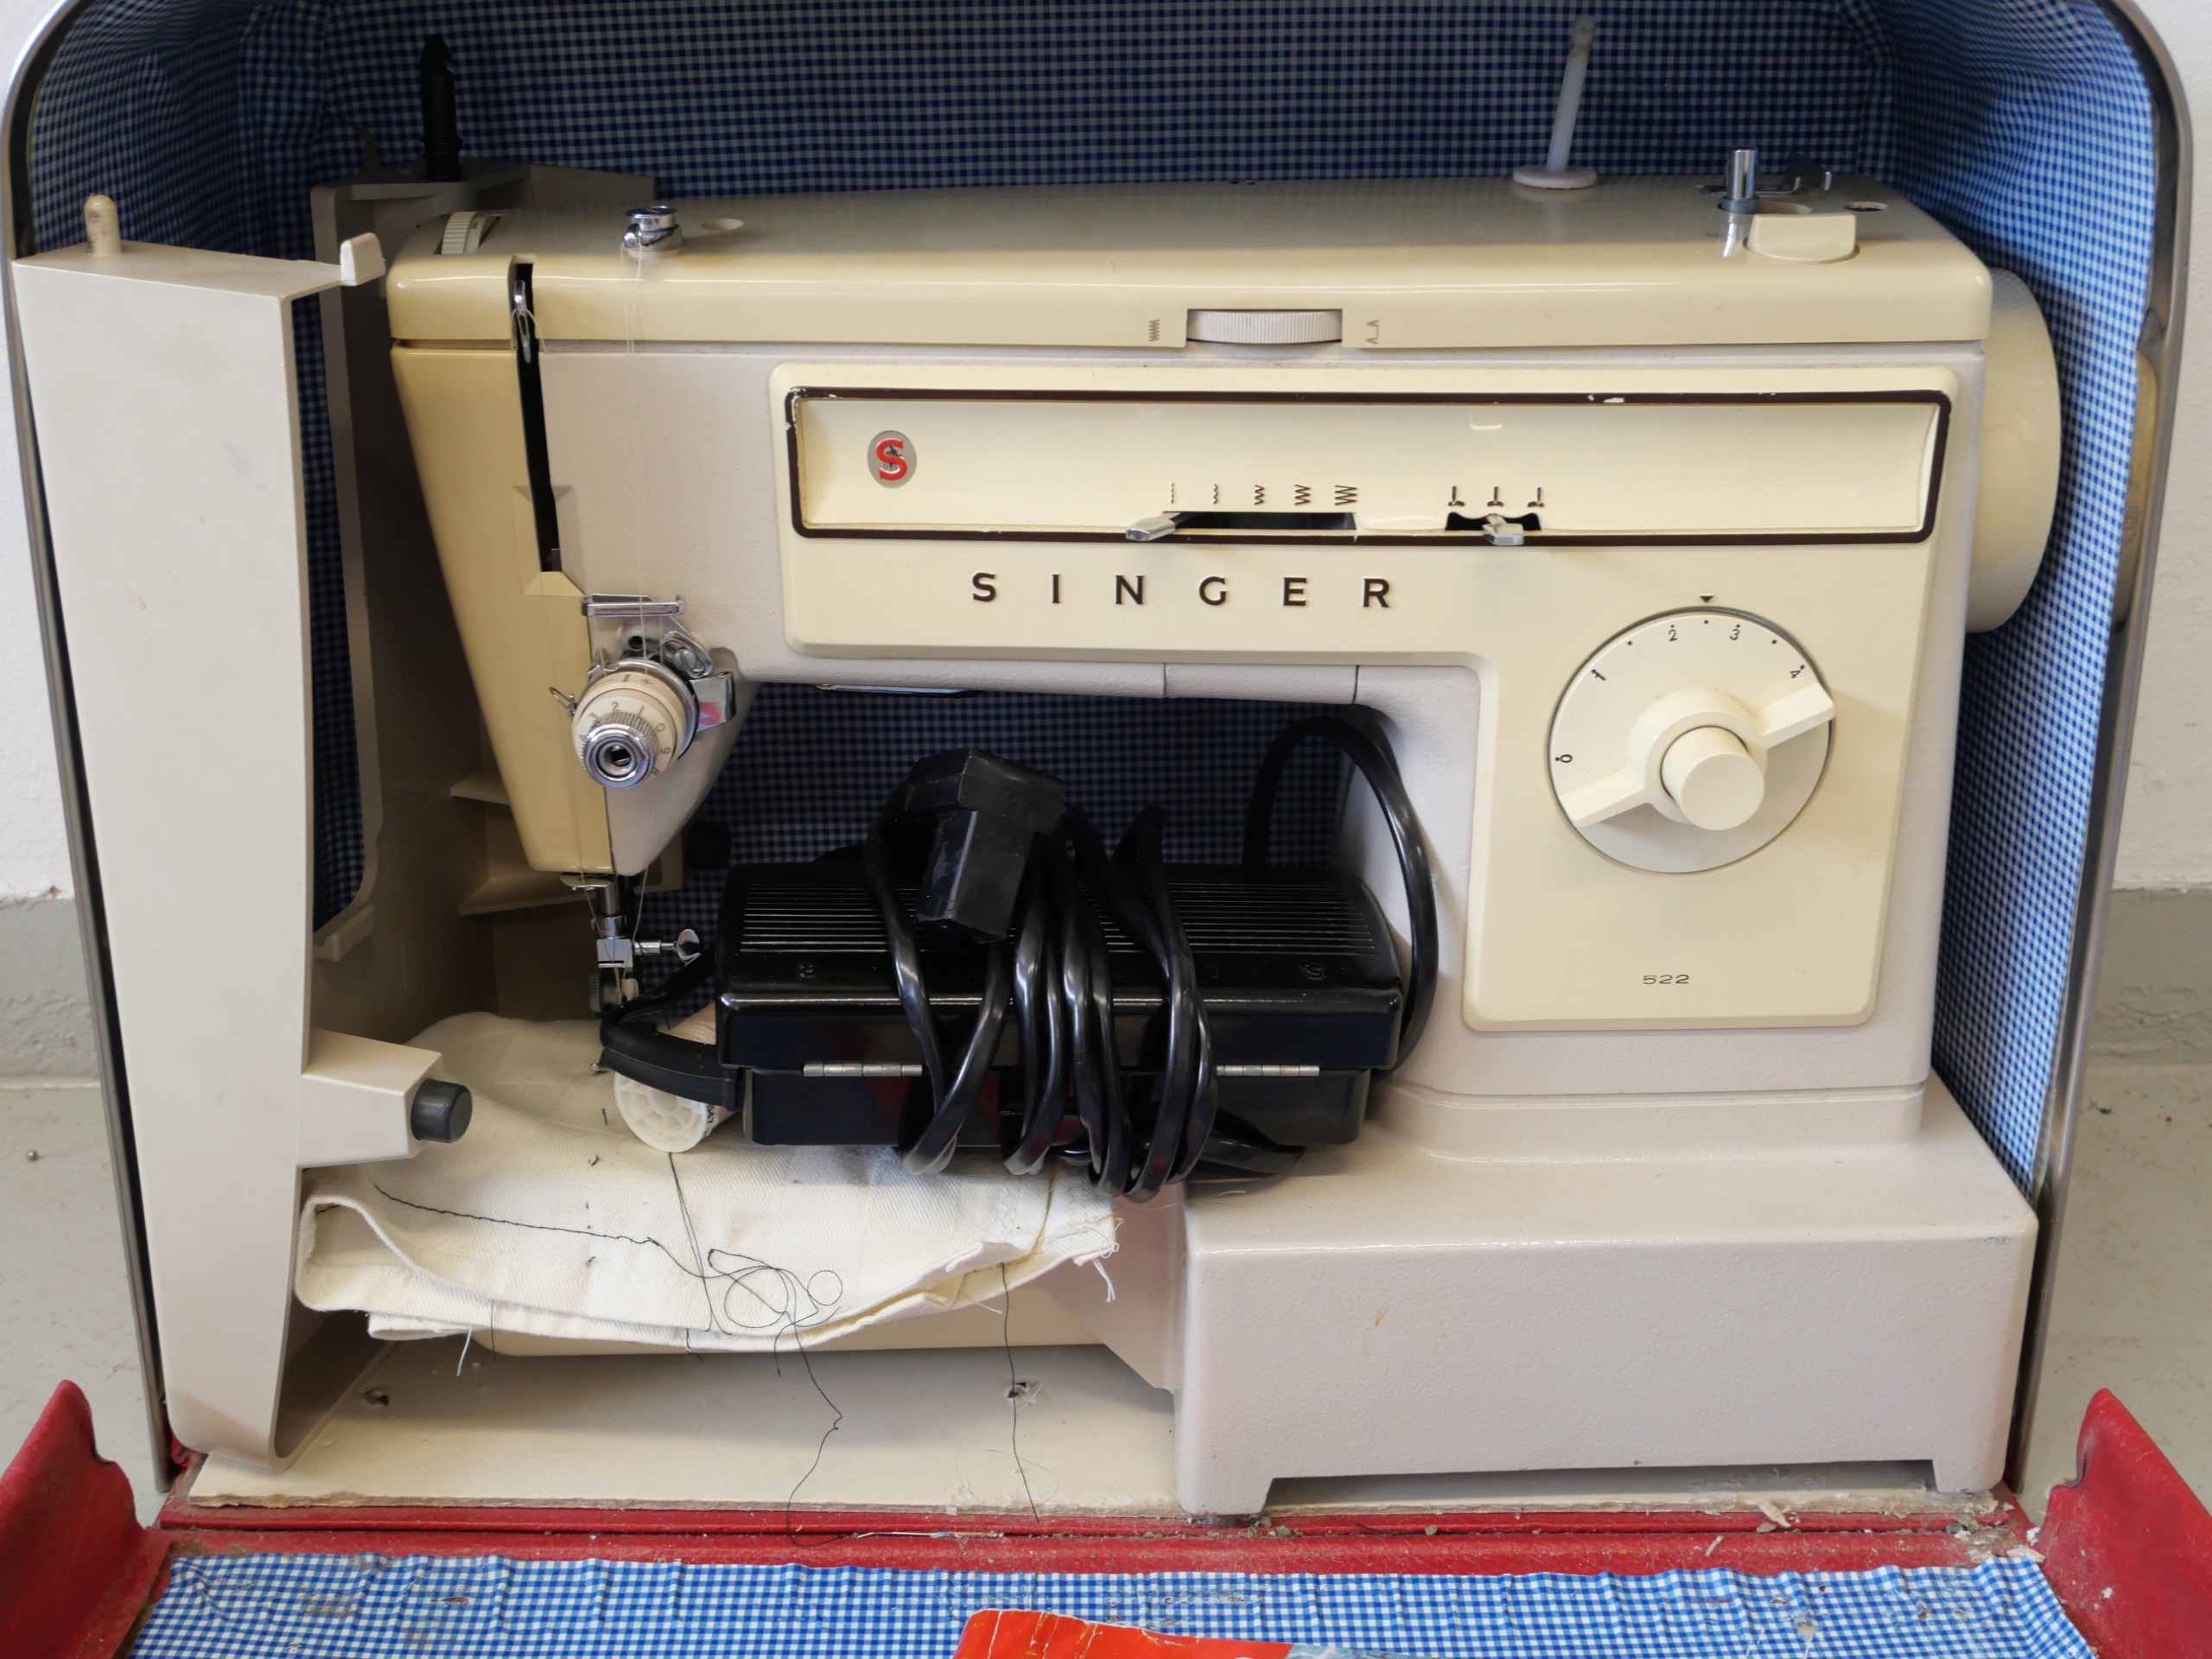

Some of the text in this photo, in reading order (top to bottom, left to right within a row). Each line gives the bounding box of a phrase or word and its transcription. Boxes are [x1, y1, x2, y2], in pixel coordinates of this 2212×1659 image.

[876, 438, 907, 480] S
[972, 571, 1391, 609] SINGER
[611, 701, 620, 713] 2
[1560, 627, 1802, 765] 0 1 2 3 4
[1643, 974, 1690, 985] 522
